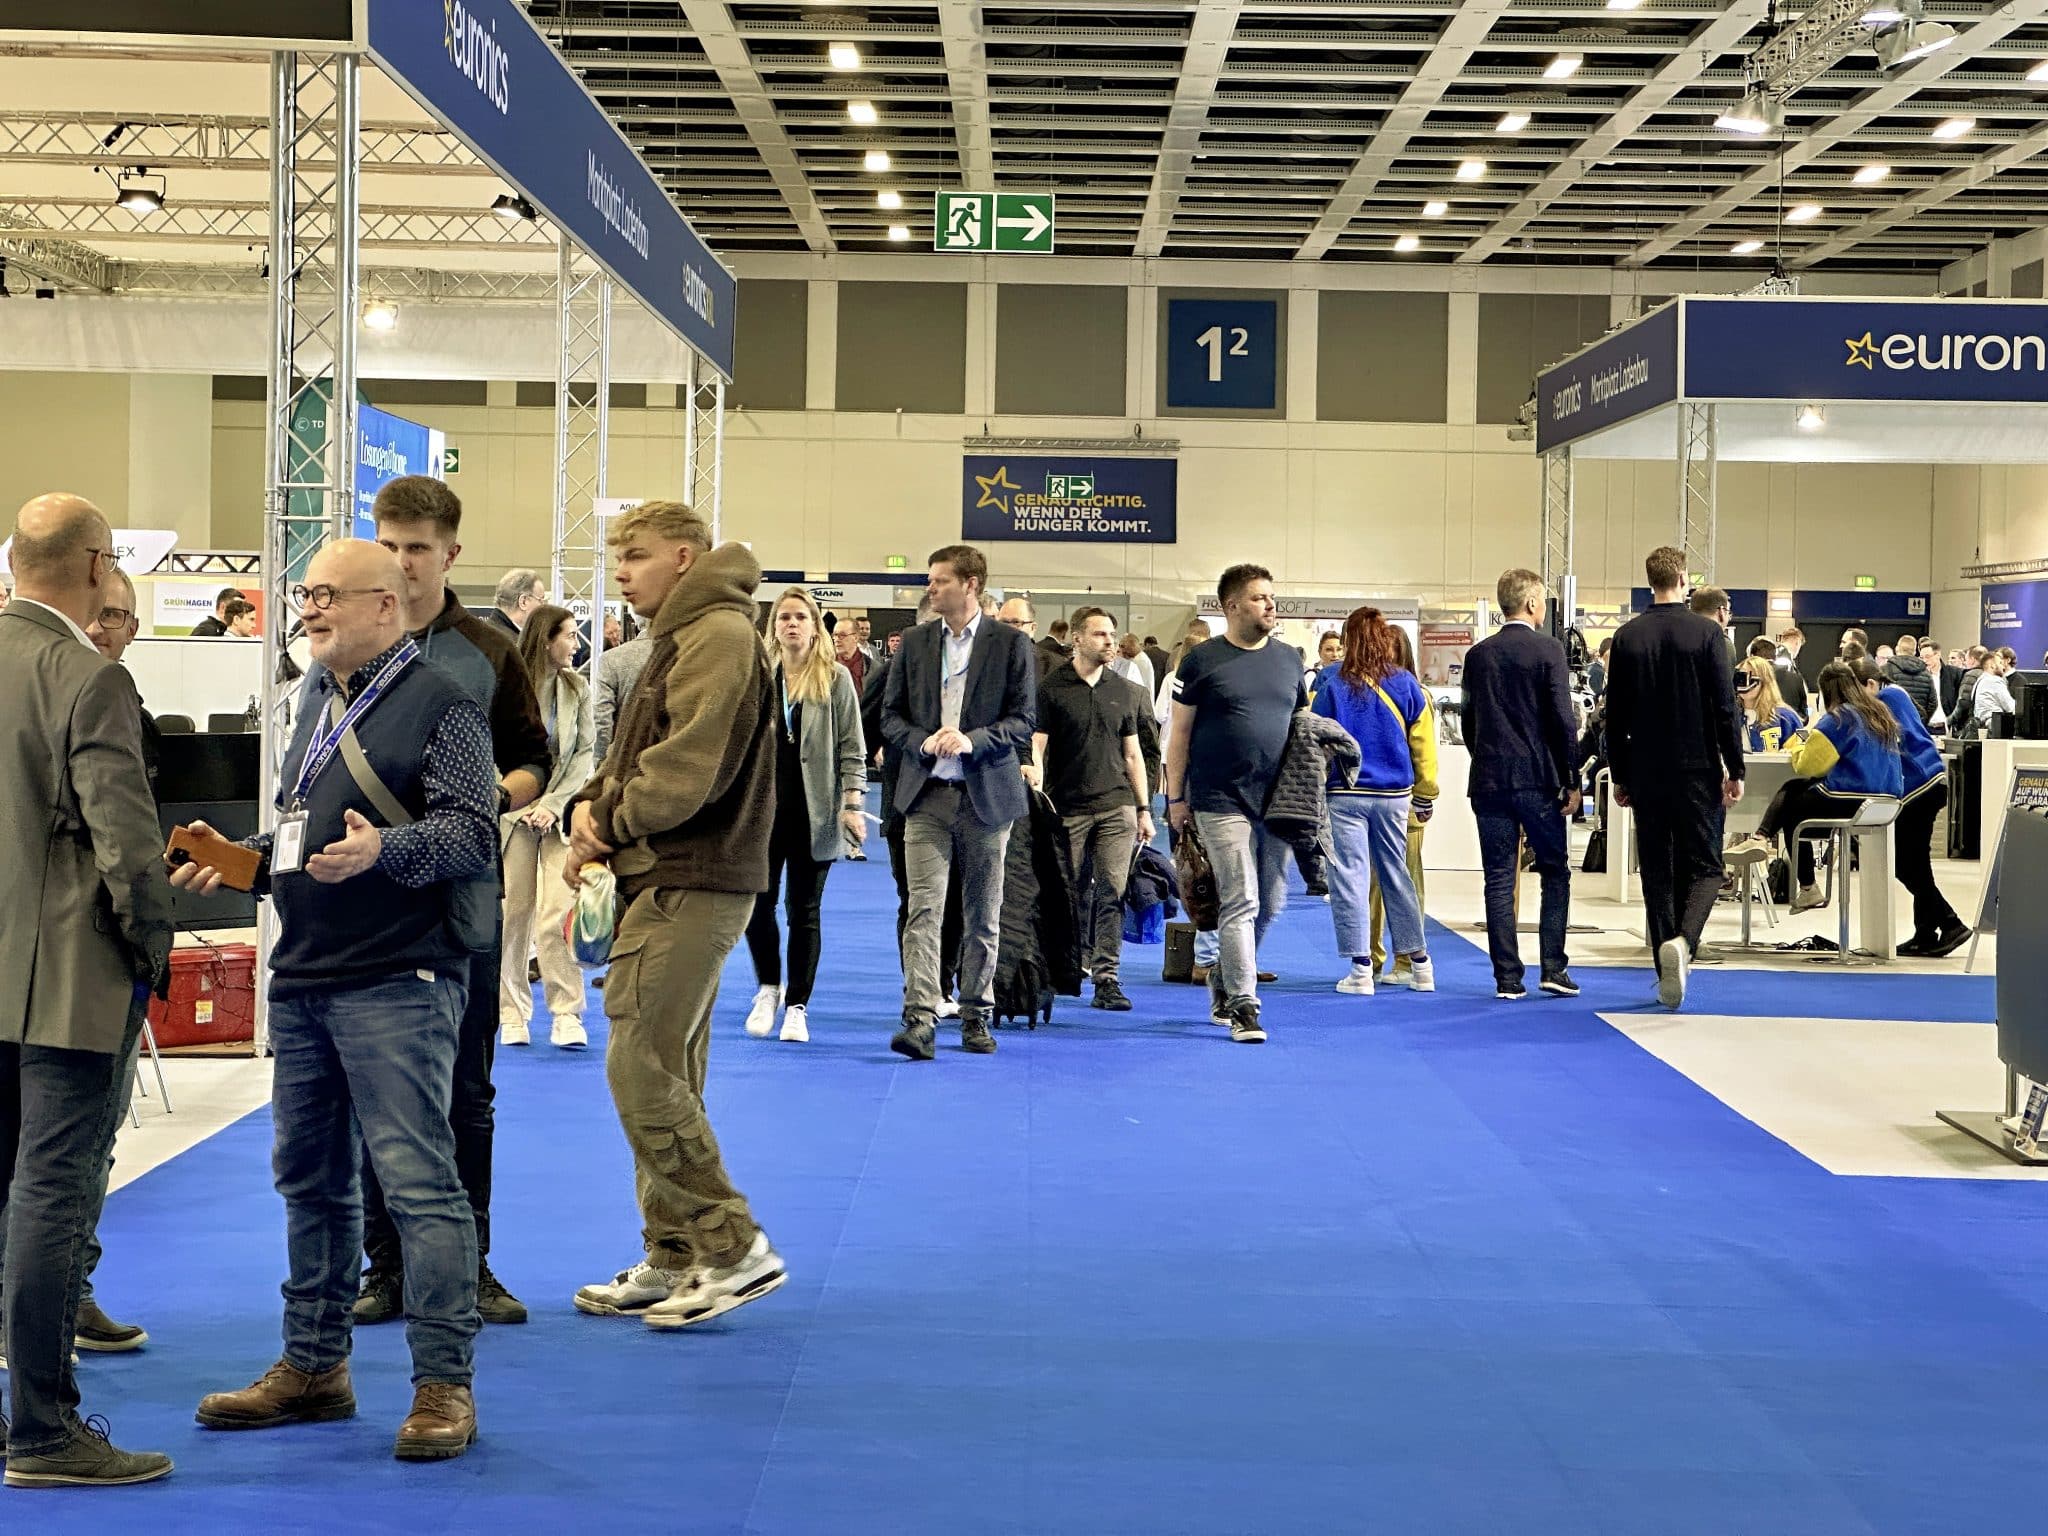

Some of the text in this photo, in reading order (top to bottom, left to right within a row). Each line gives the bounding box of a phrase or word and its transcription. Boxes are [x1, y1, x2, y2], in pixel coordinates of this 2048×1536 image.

[453, 0, 509, 115] euronics
[1881, 333, 2046, 371] euron
[1014, 506, 1102, 520] WENN DER
[1014, 519, 1151, 533] HUNGER KOMMT.
[163, 597, 213, 607] GRÜNHAGEN
[572, 605, 617, 616] PRIEX
[2018, 776, 2044, 787] GENAU
